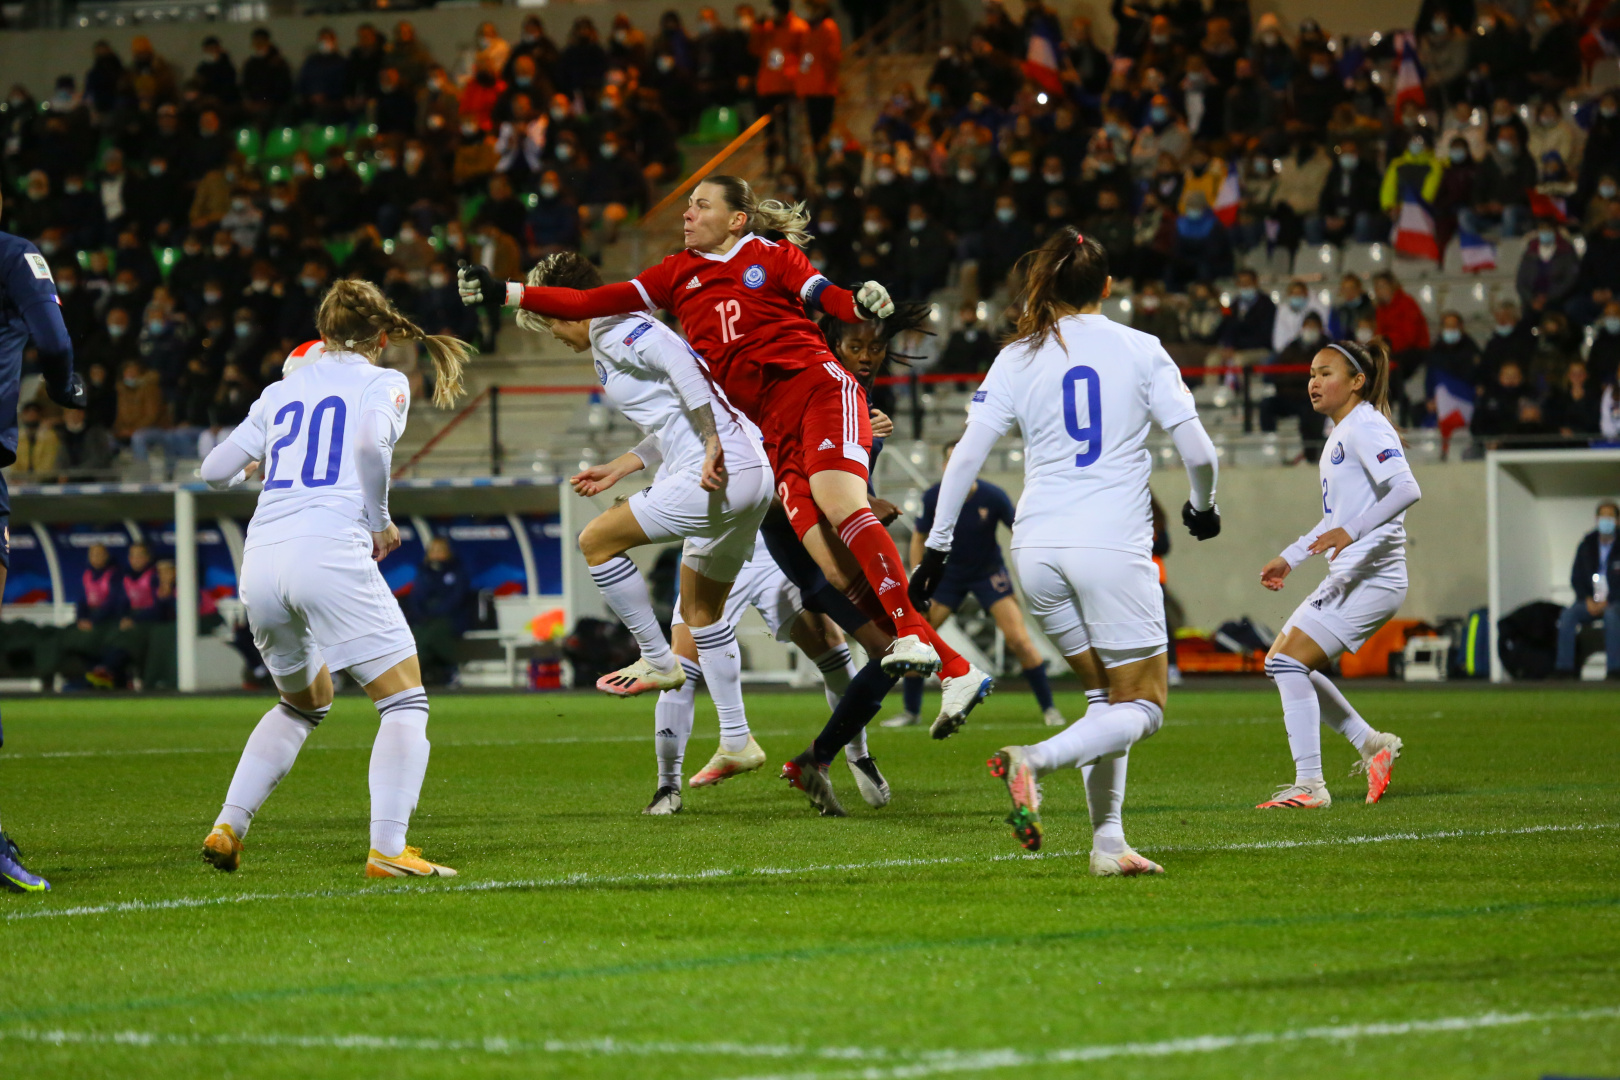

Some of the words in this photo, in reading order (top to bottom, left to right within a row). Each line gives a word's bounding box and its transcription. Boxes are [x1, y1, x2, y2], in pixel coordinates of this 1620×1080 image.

[714, 299, 745, 344] 12
[1062, 365, 1102, 468] 9
[264, 395, 347, 492] 20
[878, 581, 901, 596] adidas
[891, 607, 904, 619] 12
